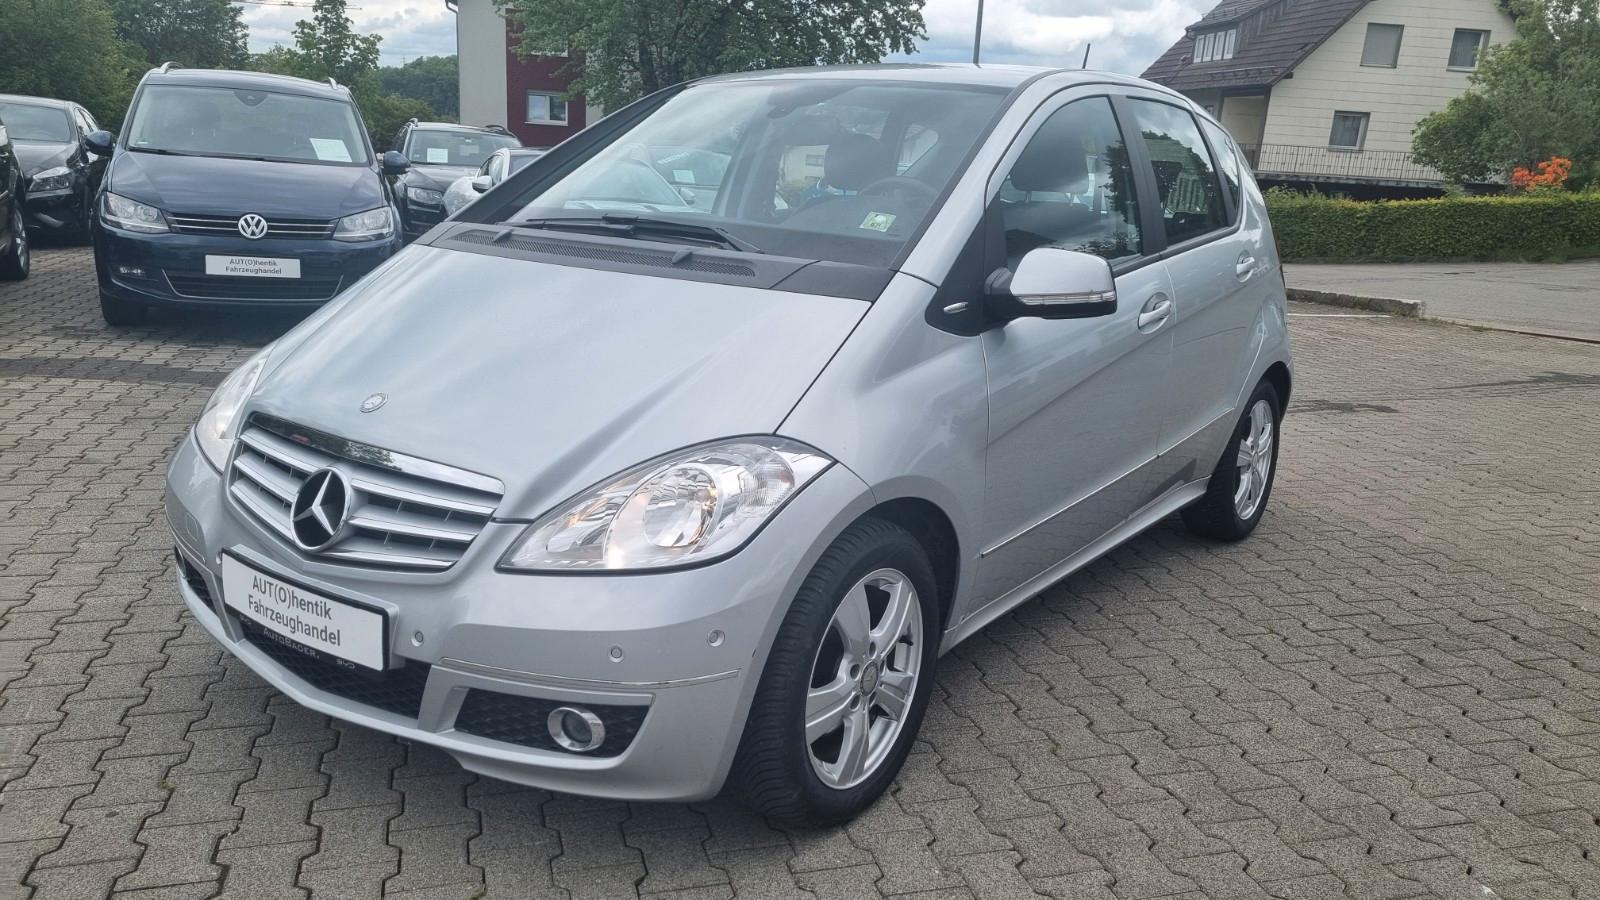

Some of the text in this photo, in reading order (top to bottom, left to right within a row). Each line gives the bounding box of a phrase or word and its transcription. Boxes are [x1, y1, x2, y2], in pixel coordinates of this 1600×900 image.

[225, 266, 282, 275] Fahrzeughandel
[229, 258, 278, 267] AUT(O)hentik
[252, 575, 333, 620] AUT(O)hentik
[248, 594, 341, 646] Fahrzeughandel
